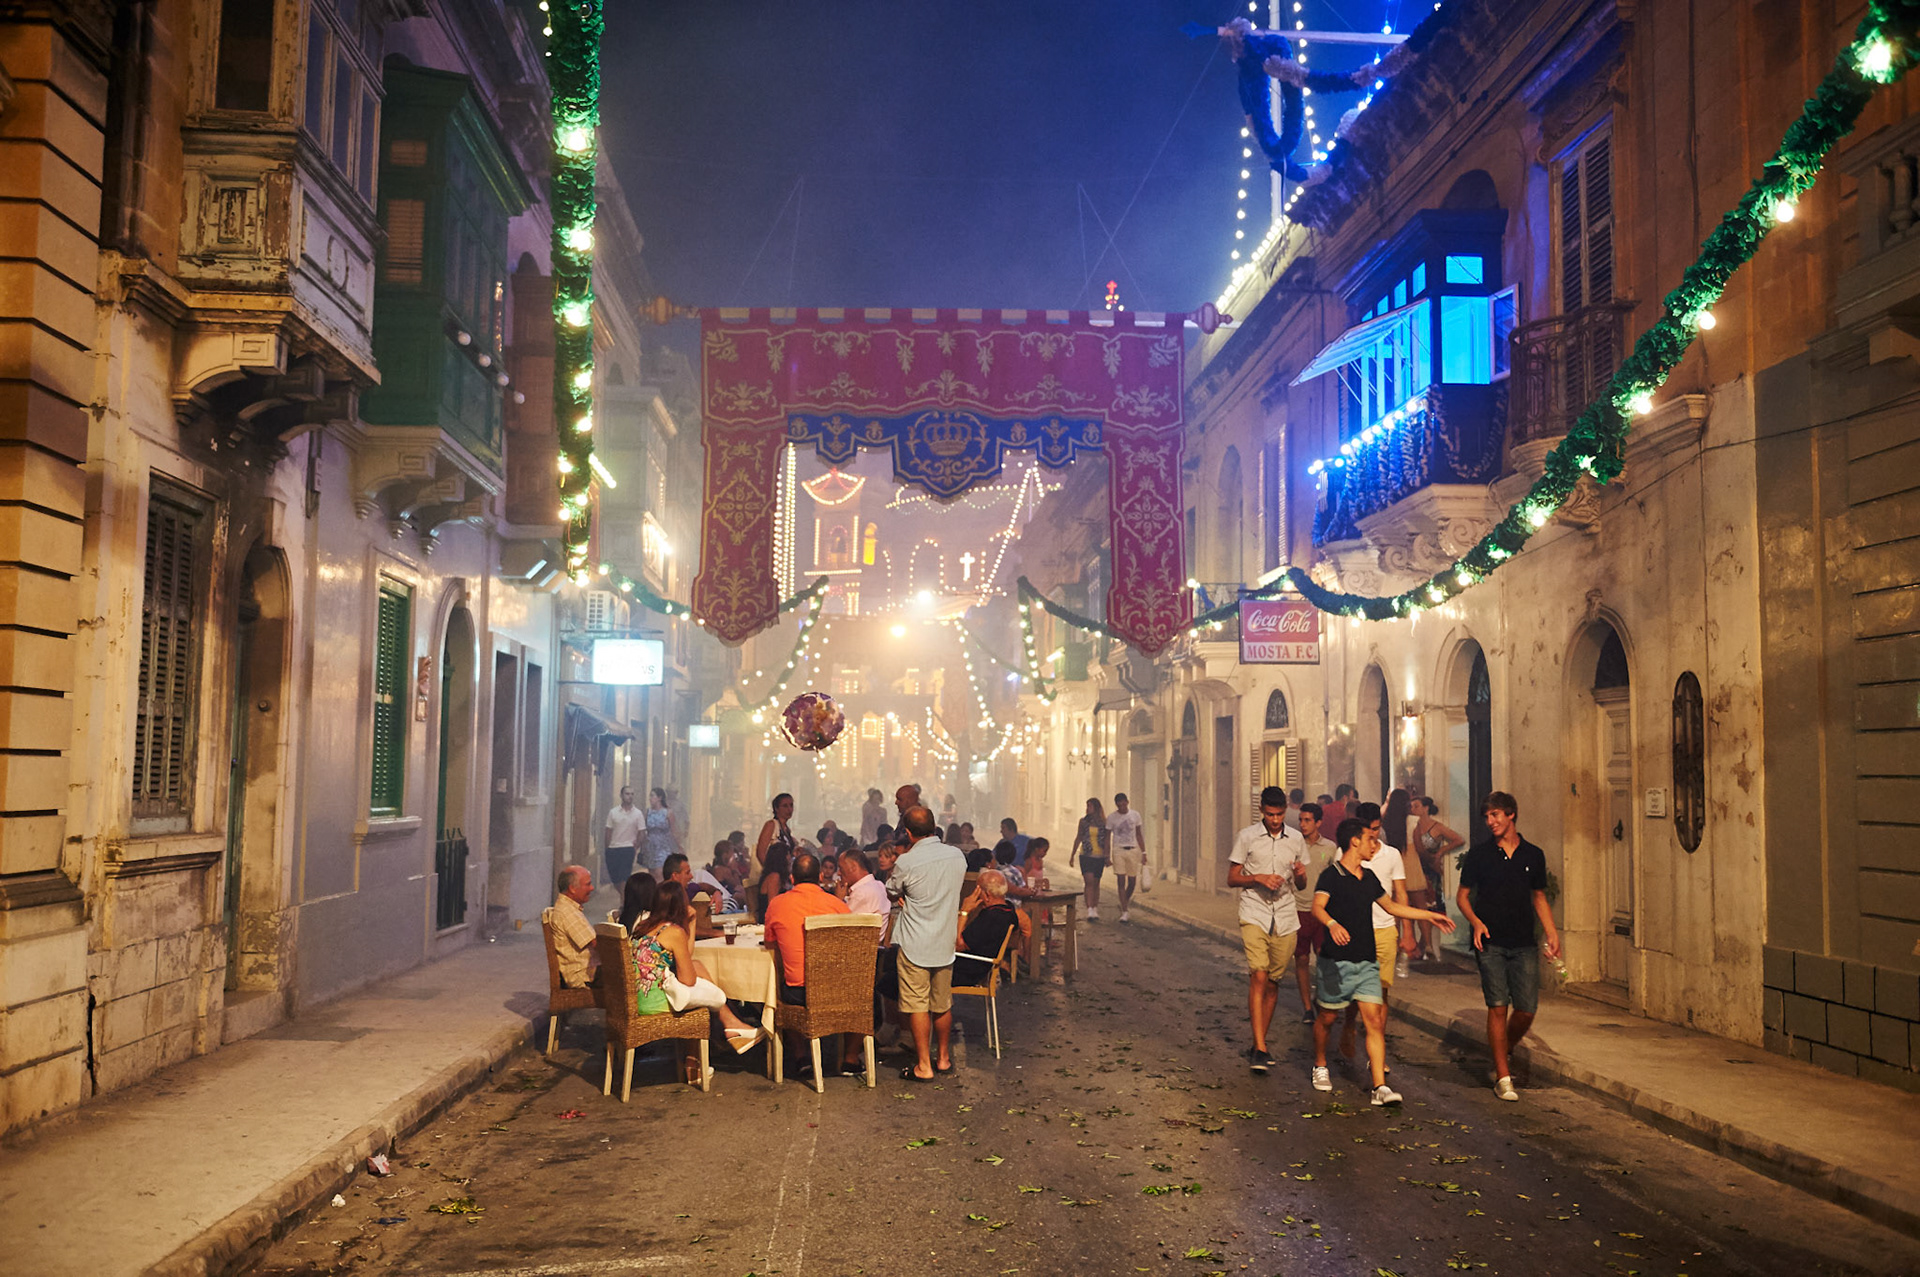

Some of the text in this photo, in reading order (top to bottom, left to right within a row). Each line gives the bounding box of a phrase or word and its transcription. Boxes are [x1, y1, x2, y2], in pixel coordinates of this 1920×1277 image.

[1247, 609, 1313, 633] Coca-Cola
[1247, 645, 1317, 659] MOSTA F.C.
